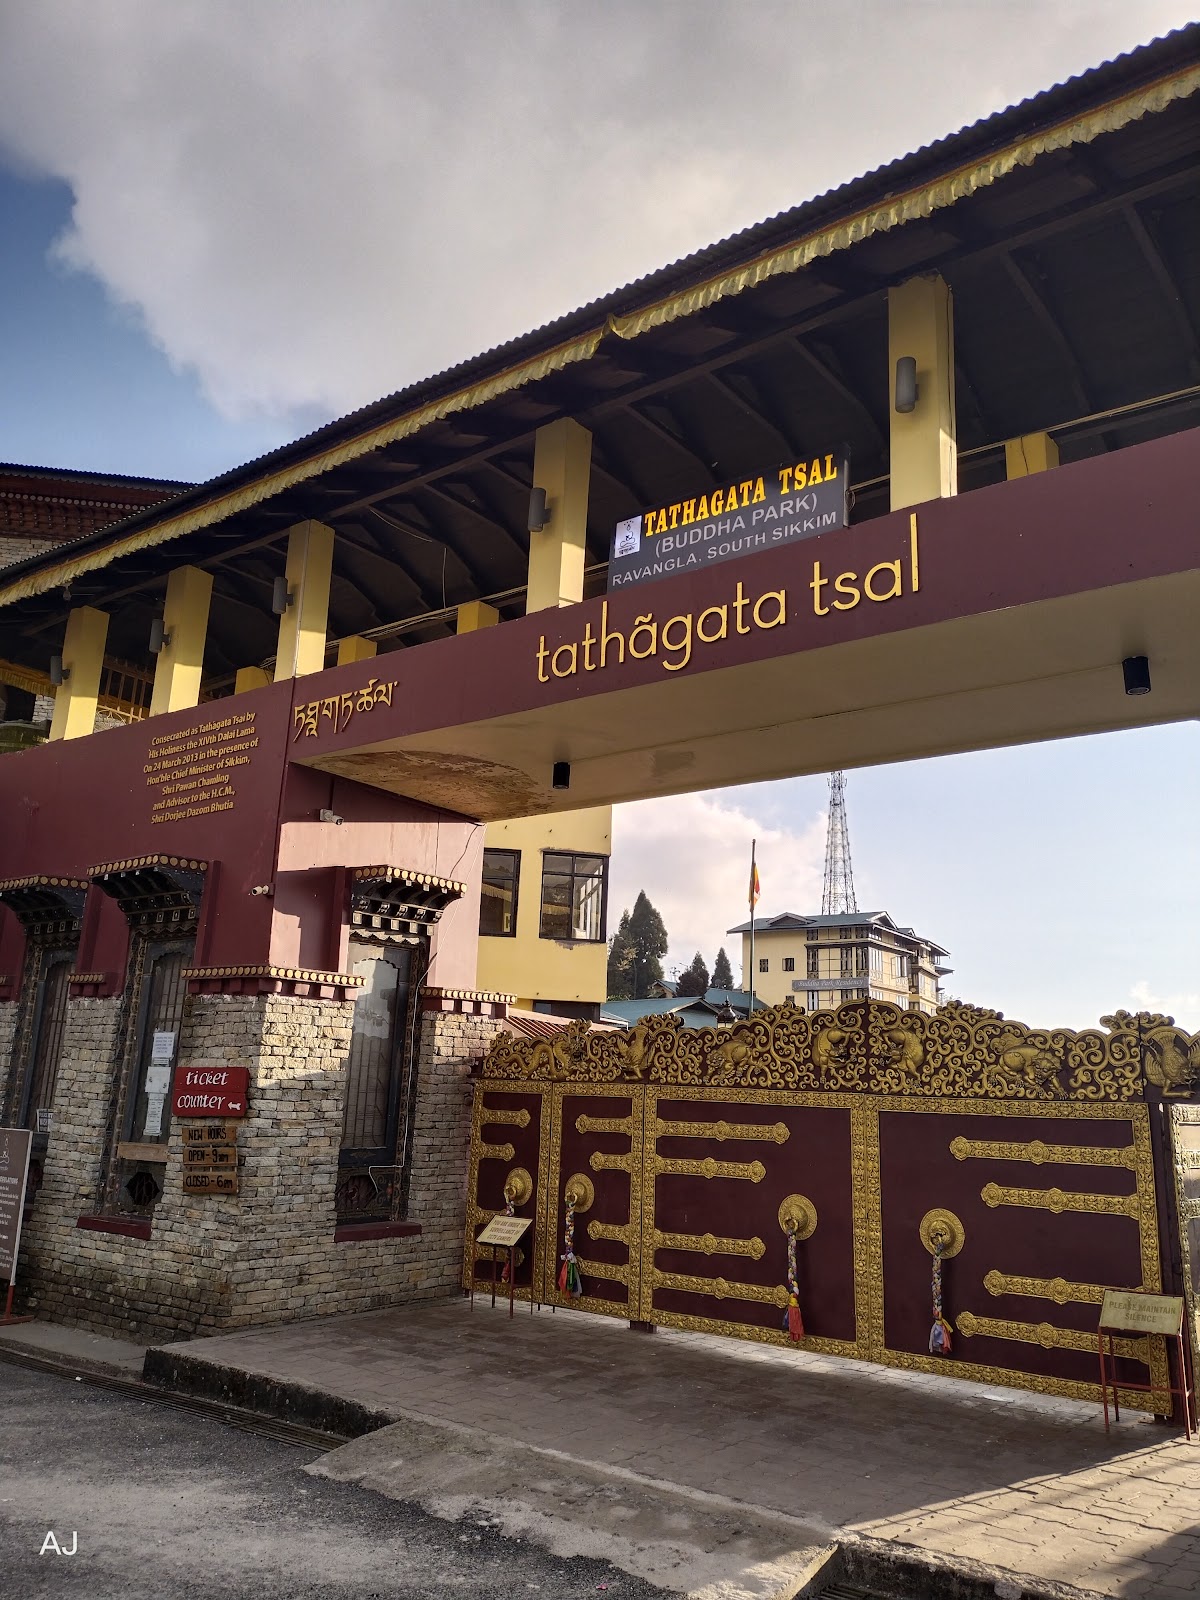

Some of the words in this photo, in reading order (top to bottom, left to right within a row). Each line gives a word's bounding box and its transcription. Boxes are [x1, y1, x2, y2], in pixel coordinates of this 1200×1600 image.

[644, 477, 767, 537] TATHAGATA
[779, 454, 838, 495] TSAL
[655, 515, 746, 558] (BUDDHA
[752, 492, 818, 526] PARK)
[707, 532, 766, 559] SOUTH
[772, 511, 837, 541] SIKKIM
[809, 513, 919, 616] tsal
[151, 728, 190, 746] Consecrated
[246, 712, 256, 723] by
[160, 744, 186, 756] Holiness
[187, 740, 198, 750] the
[199, 734, 217, 747] XIVth
[218, 729, 236, 741] Dalai
[236, 726, 255, 738] Lama
[143, 764, 153, 774] On
[153, 762, 161, 771] 24
[161, 757, 181, 770] March
[182, 753, 199, 765] 2013
[199, 751, 206, 760] in
[206, 748, 218, 758] the
[219, 741, 250, 757] presence
[250, 737, 259, 747] of
[171, 768, 189, 780] Chief
[189, 762, 216, 775] Minister
[216, 760, 225, 769] of
[162, 785, 175, 795] Shri
[175, 781, 197, 792] Pawan
[197, 774, 230, 787] Chamling
[151, 813, 165, 824] Shri
[164, 810, 186, 822] Dorjee
[186, 805, 210, 817] Dazom
[210, 800, 234, 813] Bhutia
[152, 800, 166, 811] and
[166, 796, 191, 808] Advisor
[191, 793, 199, 802] to
[199, 791, 211, 800] the
[185, 1070, 230, 1086] ticket
[177, 1094, 226, 1110] counter
[188, 1129, 203, 1141] NEW
[207, 1127, 227, 1140] HOURS
[1109, 1300, 1138, 1311] PLEASE
[1138, 1304, 1176, 1315] MAINTAIN
[1125, 1312, 1157, 1323] SILENCE
